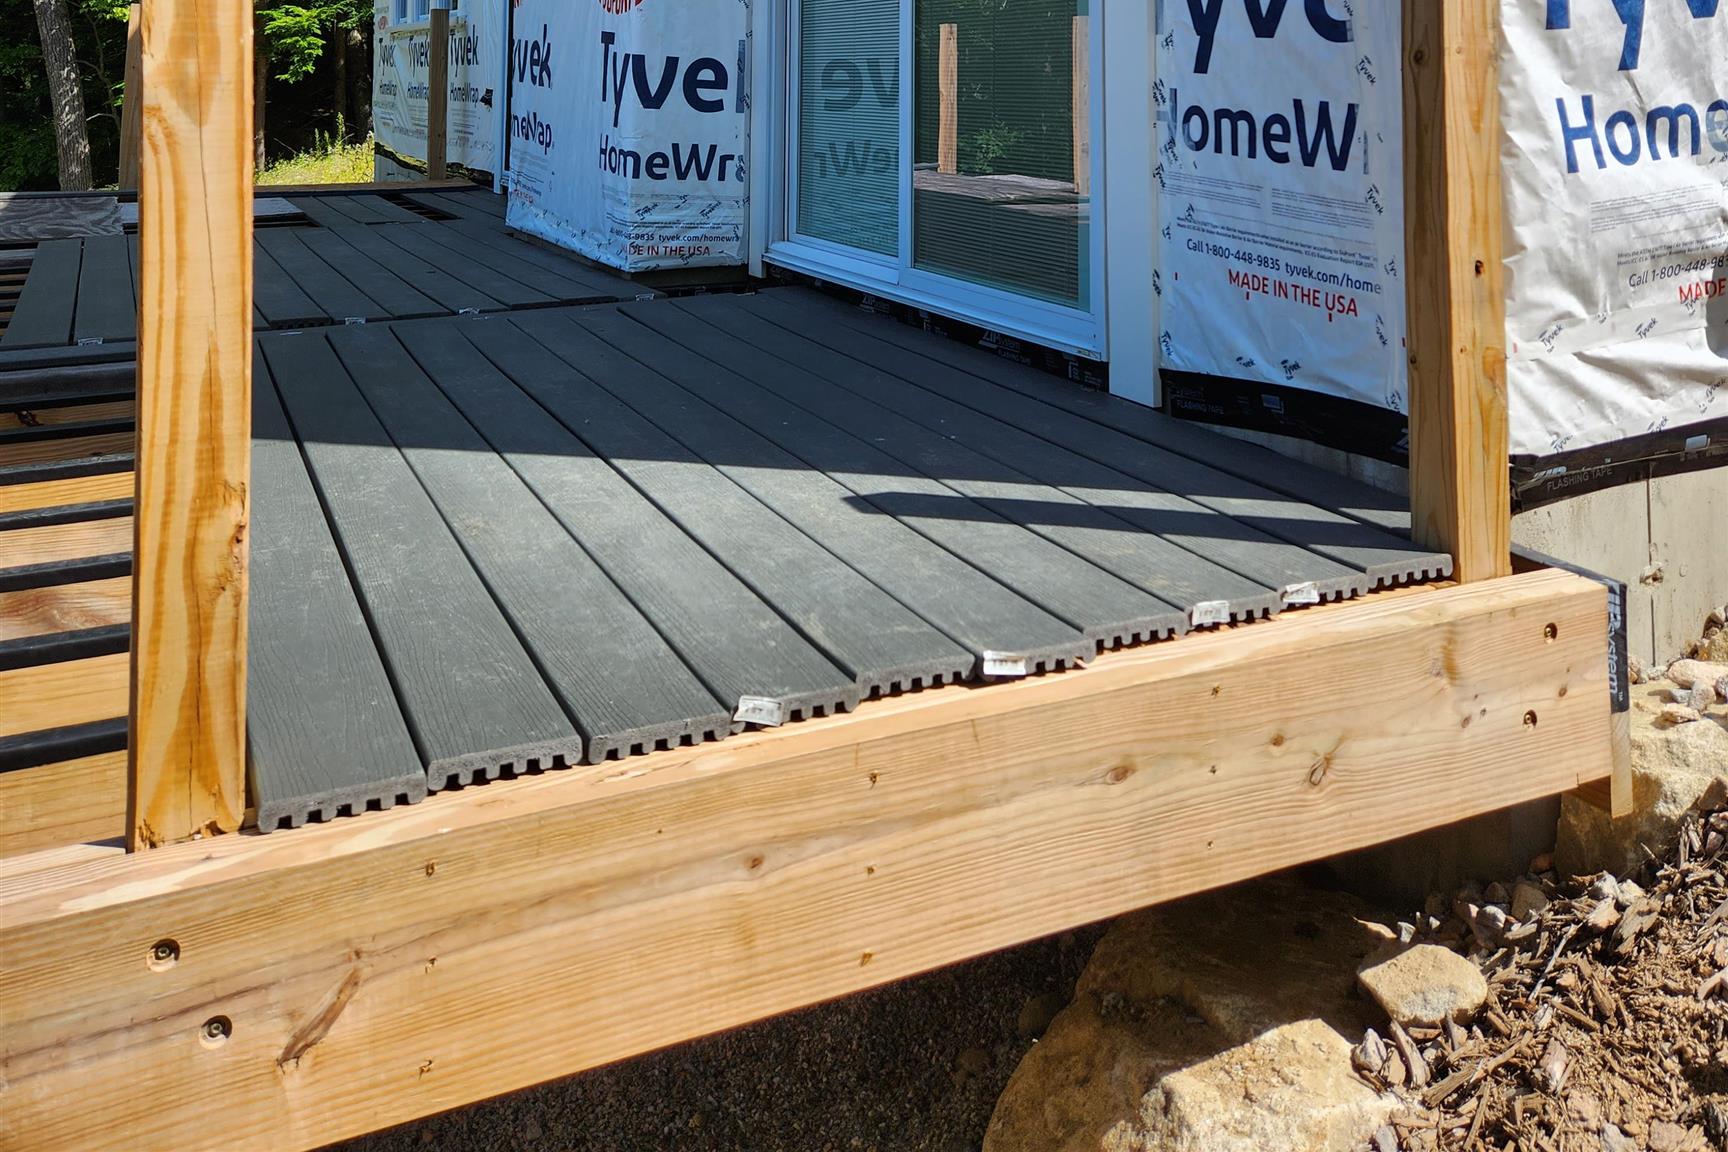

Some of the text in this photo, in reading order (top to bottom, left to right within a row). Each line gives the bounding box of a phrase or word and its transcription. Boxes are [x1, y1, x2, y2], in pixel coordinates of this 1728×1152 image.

[449, 23, 480, 78] Tyvek
[1359, 58, 1377, 86] Tyvek
[1154, 164, 1167, 189] Tyvek
[1366, 186, 1385, 216] Tyvek
[646, 244, 711, 256] IN THE USA
[1187, 237, 1204, 254] Call
[1205, 242, 1281, 271] 1-800-448-9835
[1628, 270, 1650, 289] Call
[1228, 268, 1358, 318] MADE IN THE USA
[1540, 323, 1564, 348] Tyvek
[1637, 317, 1659, 341] Tyvek
[1161, 332, 1174, 357] Tyvek
[1283, 359, 1302, 376] Tyvek
[1705, 377, 1727, 399] Tyvek
[1547, 466, 1613, 492] FLASHING TAPE
